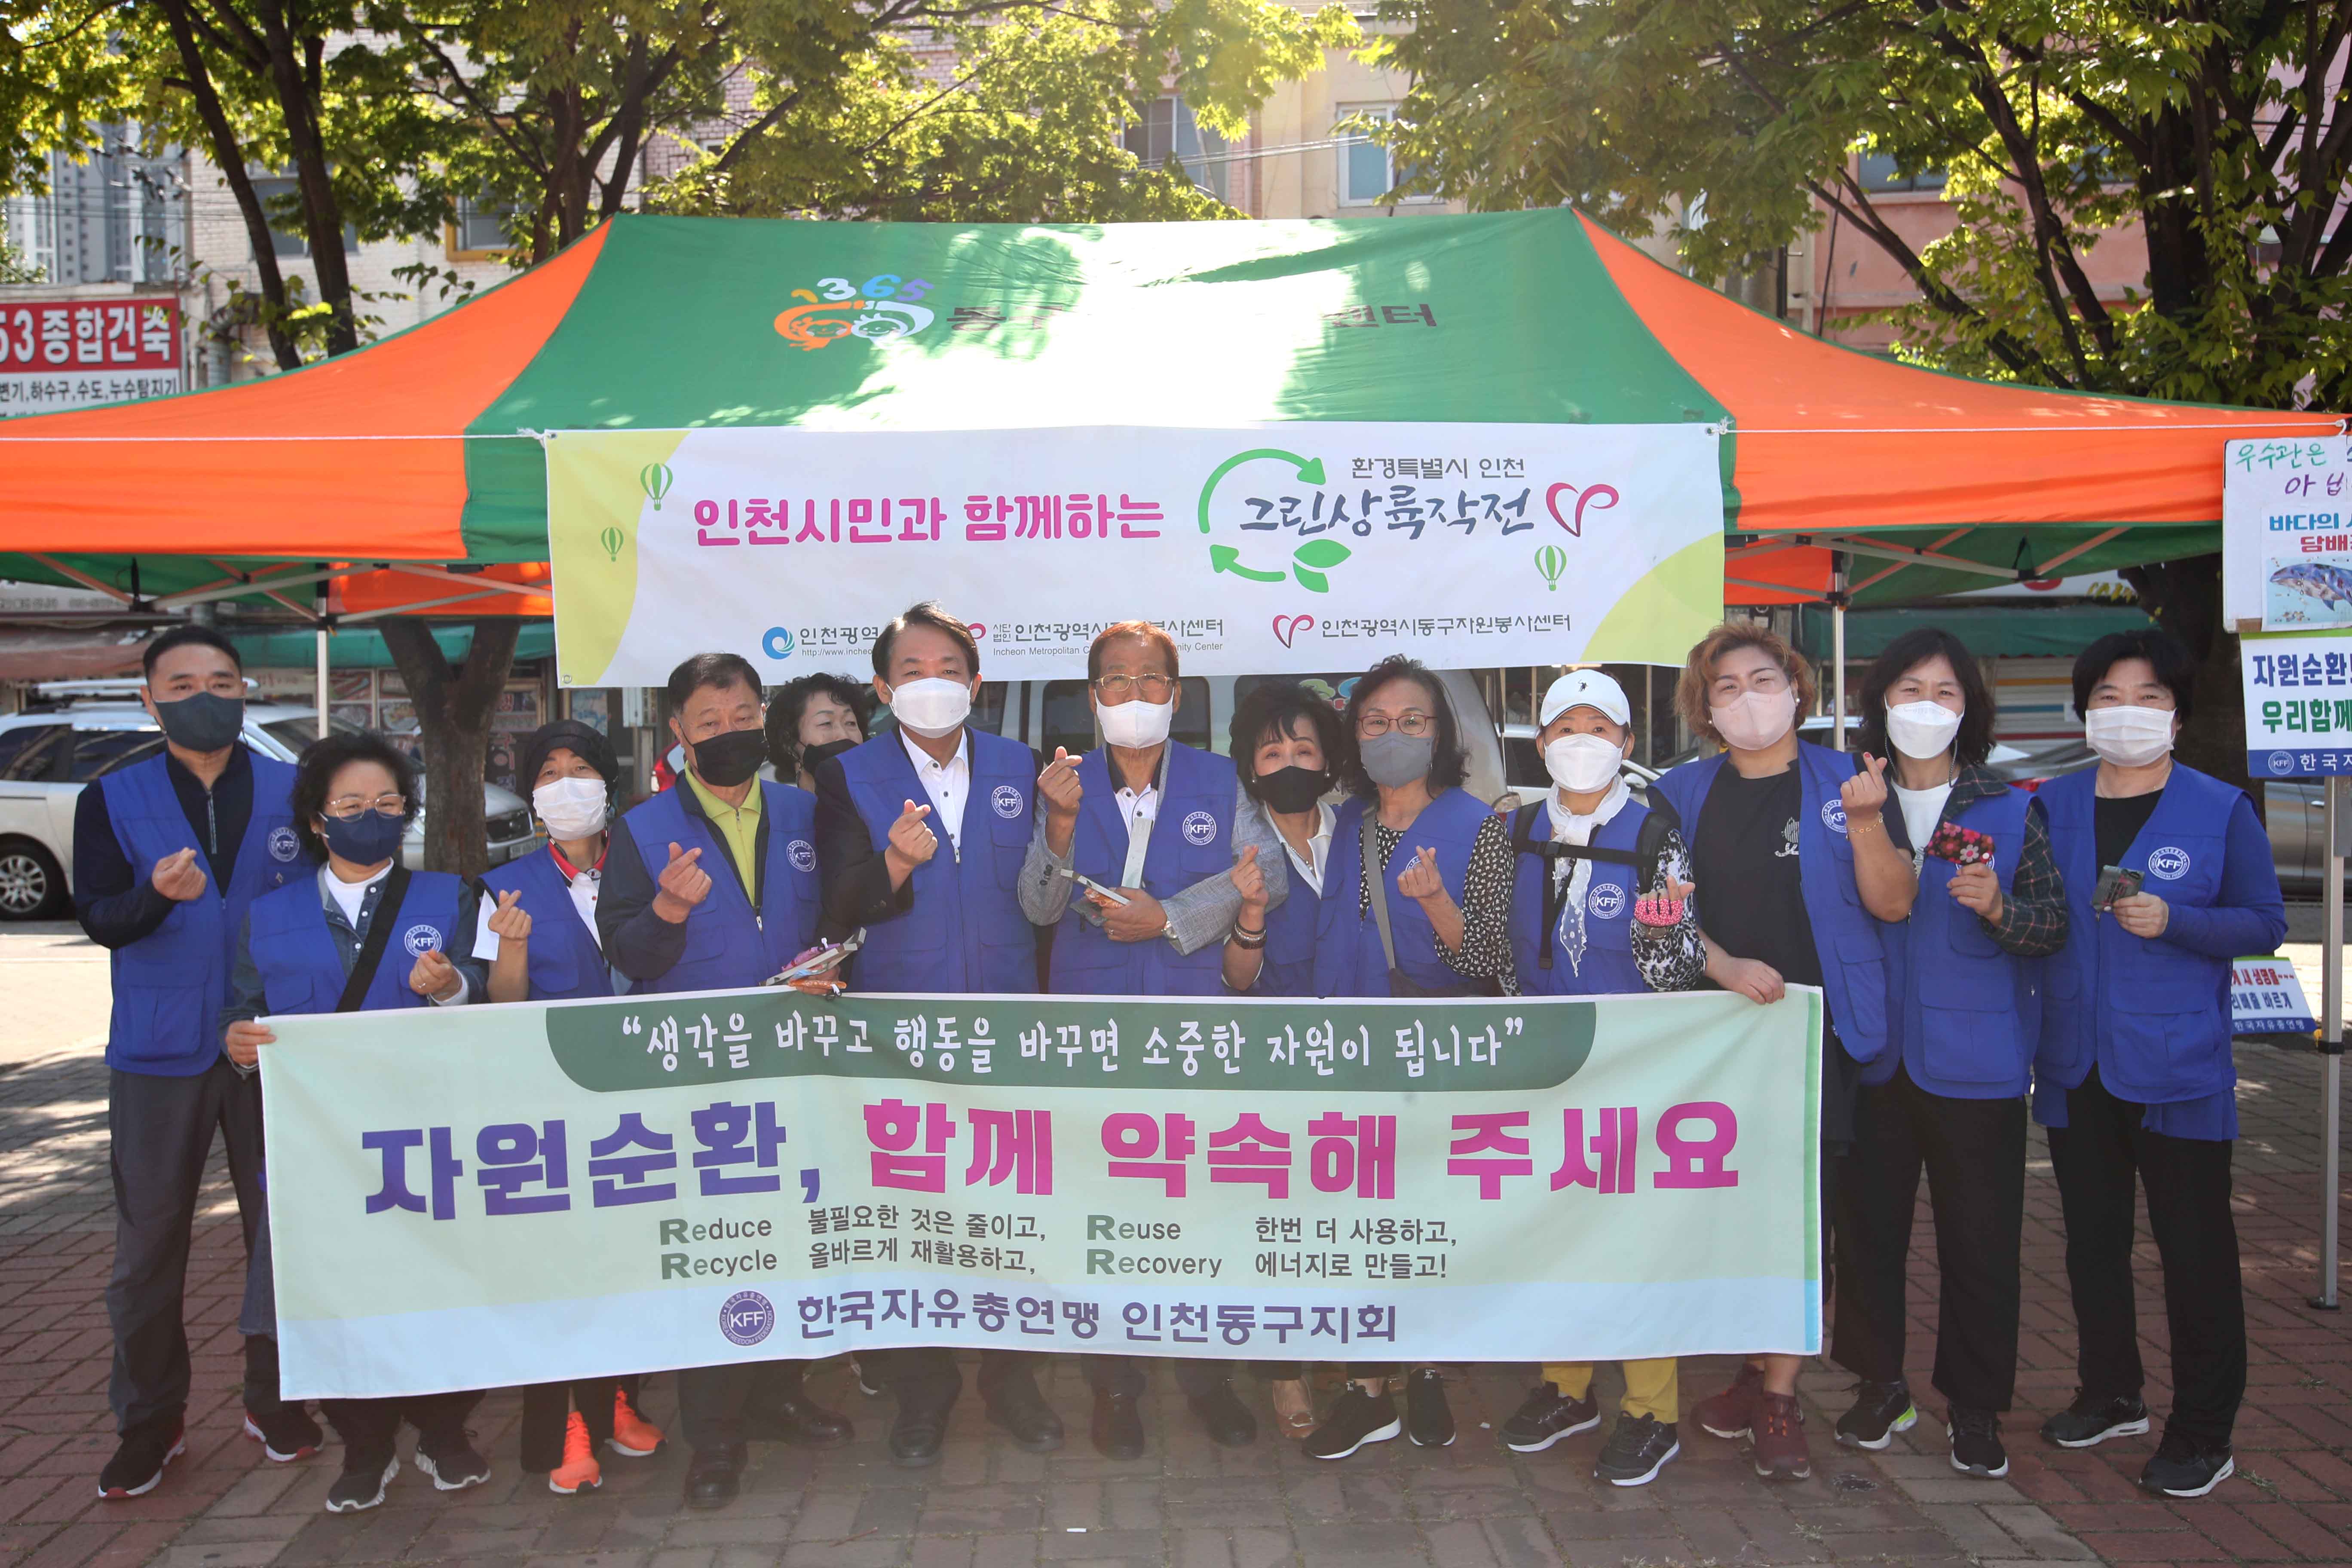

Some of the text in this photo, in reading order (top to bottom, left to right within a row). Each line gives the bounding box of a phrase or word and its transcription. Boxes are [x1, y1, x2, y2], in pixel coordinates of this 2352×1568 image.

[1352, 457, 1525, 479] 환경특별시 인천
[2236, 442, 2327, 472] 우수관은
[694, 493, 1164, 547] 인천시민과 함께하는
[1240, 484, 1535, 540] 그린상륙작전
[2269, 512, 2339, 532] 바다의
[800, 627, 879, 646] 인천광역
[993, 624, 1011, 633] 사단
[1322, 614, 1570, 637] 인천광역시동구자원봉사센터
[993, 634, 1011, 643] 법인
[1195, 643, 1223, 651] Center
[802, 648, 873, 657] http://www.incheo
[1029, 646, 1080, 656] Metropolitan
[2252, 652, 2352, 687] 자원순환
[998, 798, 1017, 807] KFF
[1830, 812, 1846, 822] KF
[1190, 824, 1210, 833] KFF
[276, 840, 294, 851] KFF
[793, 851, 811, 861] KFF
[2157, 858, 2181, 869] KFF
[1596, 896, 1618, 907] KFF
[413, 937, 434, 947] KFF
[775, 1010, 873, 1057] 바꾸고
[894, 1014, 996, 1073] 행동을
[1019, 1018, 1119, 1072] 바꾸면
[1142, 1020, 1246, 1076] 소중한
[1267, 1019, 1369, 1076] 자원이
[362, 1099, 1739, 1221] 자원순환, 함께 약속해 주세요
[659, 1217, 772, 1245] Reduce
[807, 1204, 1046, 1241] 불필요한 것은 줄이고,
[1087, 1215, 1181, 1240] Reuse
[1255, 1216, 1457, 1246] 한번 더 사용하고,
[661, 1250, 777, 1280] Recycle
[808, 1237, 1035, 1275] 올바르게 재활용하고,
[1087, 1249, 1222, 1278] Recovery
[1255, 1251, 1446, 1279] 에너지로 만들고!
[730, 1311, 764, 1328] KFF
[797, 1289, 1396, 1346] 한국자유총연맹 인천동구지회
